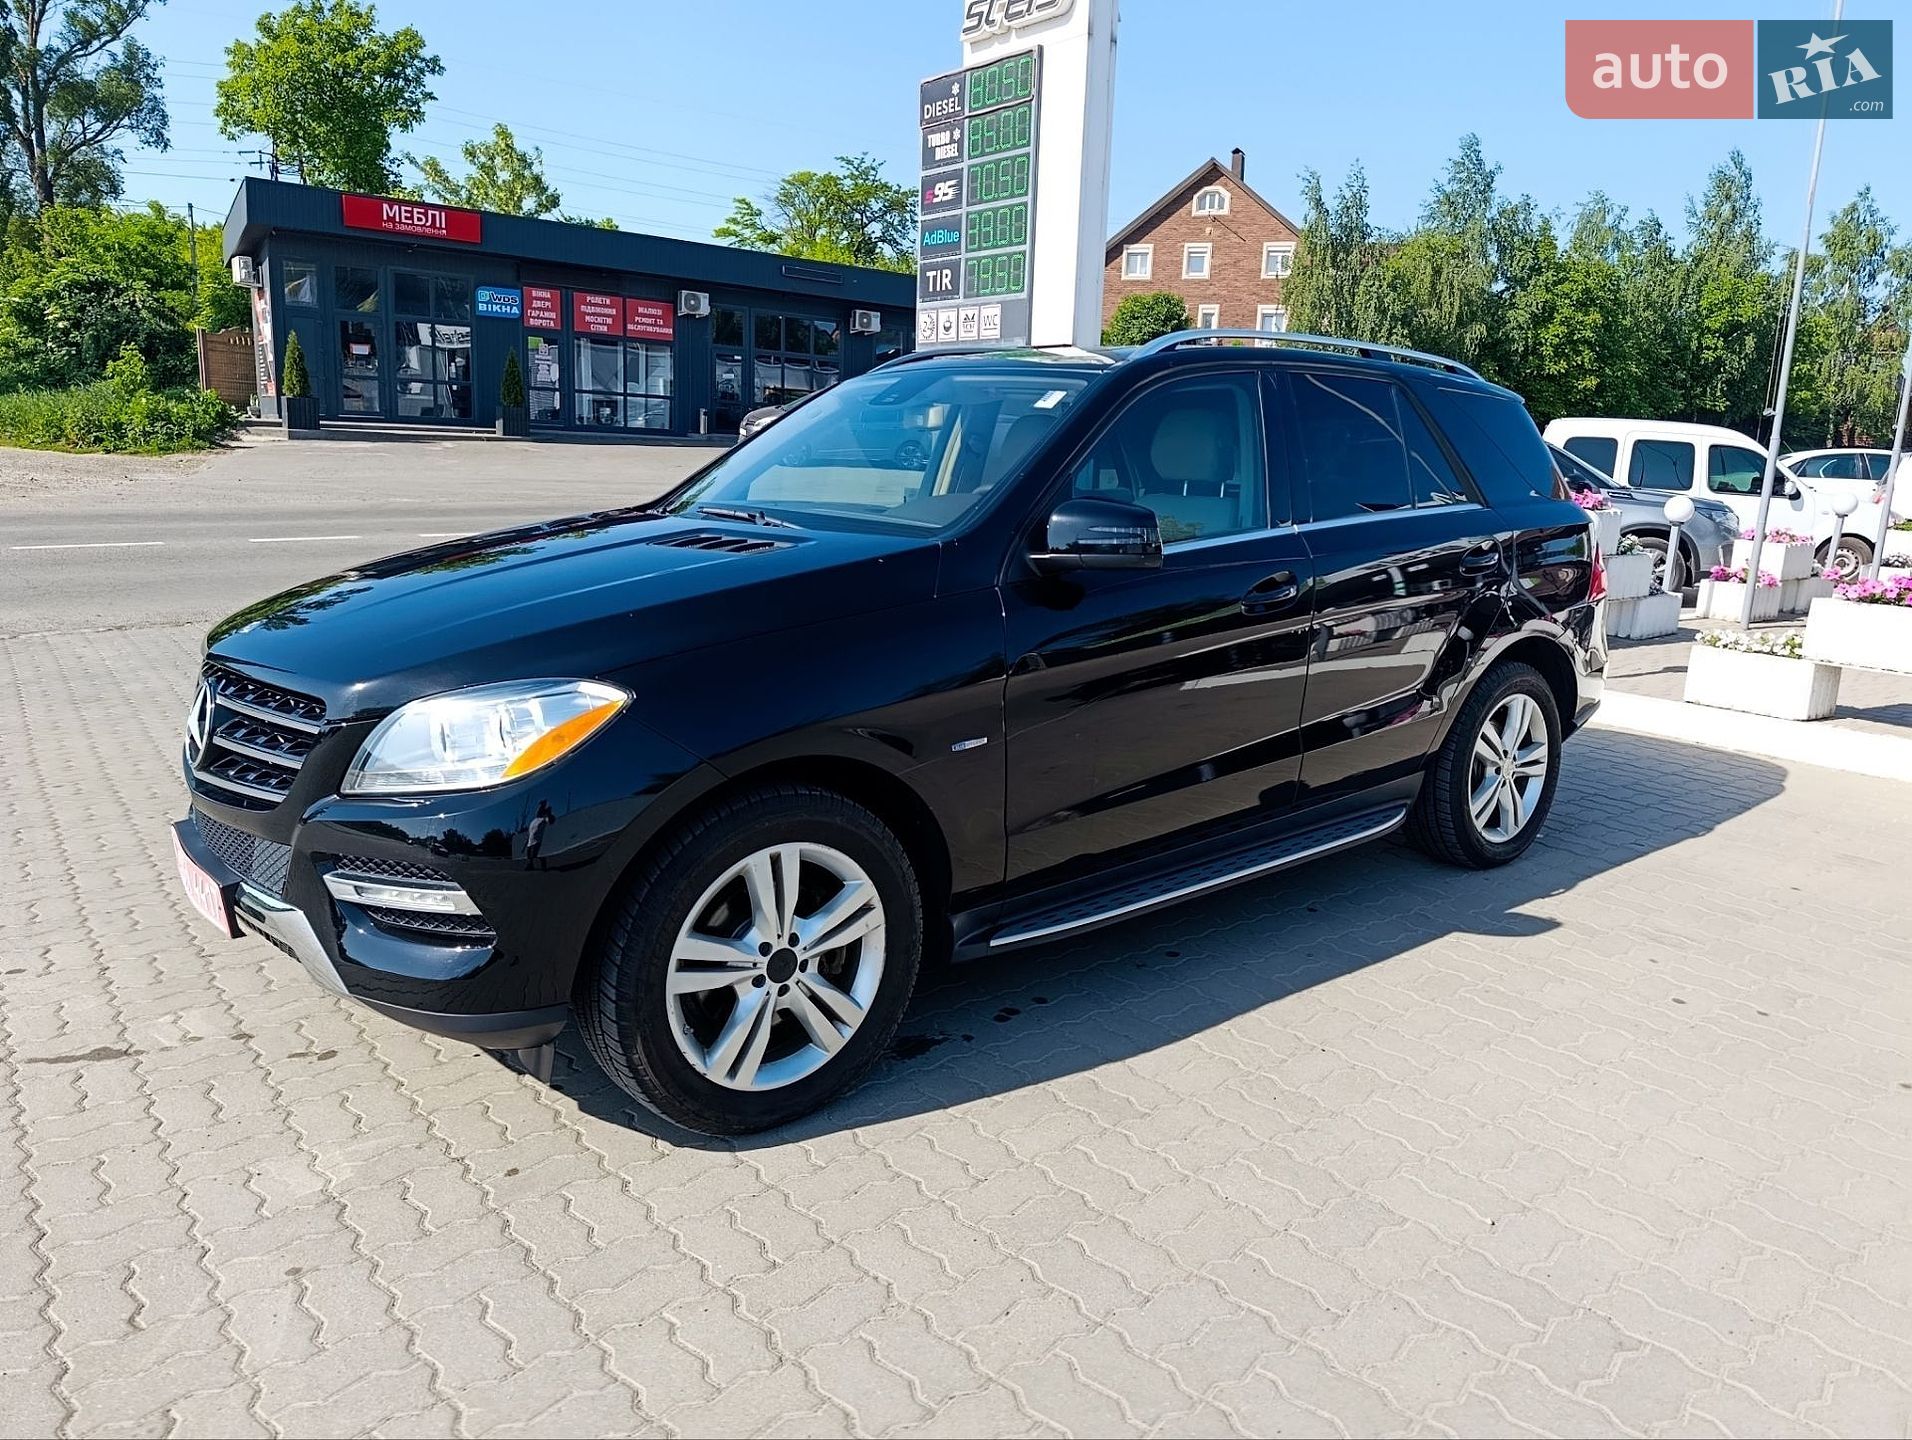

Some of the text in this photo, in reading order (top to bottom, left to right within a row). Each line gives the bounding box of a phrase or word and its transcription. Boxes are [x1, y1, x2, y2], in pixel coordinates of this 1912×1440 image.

[971, 57, 1032, 108] 80.50
[924, 97, 961, 119] DIESEL
[927, 130, 951, 148] TURBO
[970, 107, 1030, 156] 85.00
[935, 143, 959, 161] DIESEL
[970, 156, 1028, 200] 70.50
[382, 203, 446, 229] МЕБЛІ
[382, 221, 447, 236] на замовлення
[923, 229, 960, 246] AdBlue
[926, 269, 952, 292] TIR
[490, 291, 519, 304] WDS
[532, 300, 551, 308] ДВЕРІ
[479, 303, 519, 313] ВІКНА
[529, 319, 555, 327] ВОРОТА
[983, 314, 998, 327] WC
